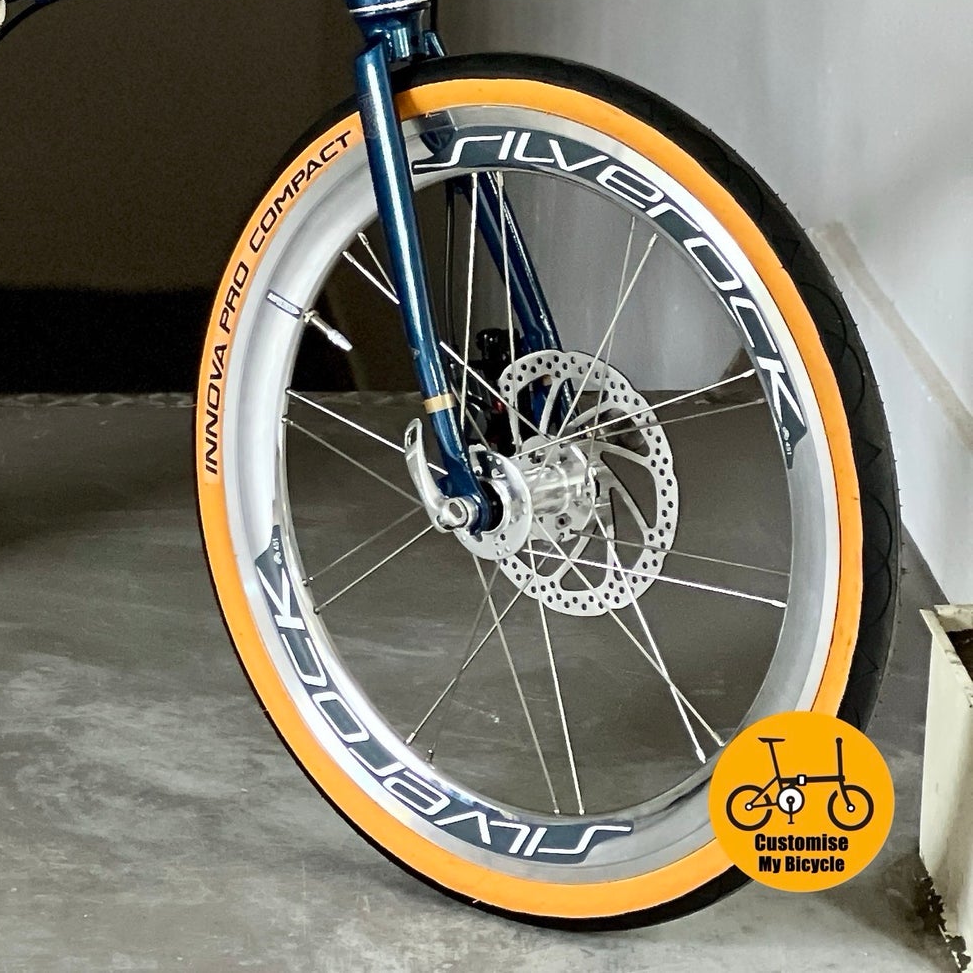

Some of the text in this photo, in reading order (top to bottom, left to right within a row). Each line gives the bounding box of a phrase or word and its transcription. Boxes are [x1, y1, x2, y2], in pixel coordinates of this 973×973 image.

[205, 130, 351, 475] INNOVA PRO COMPACT
